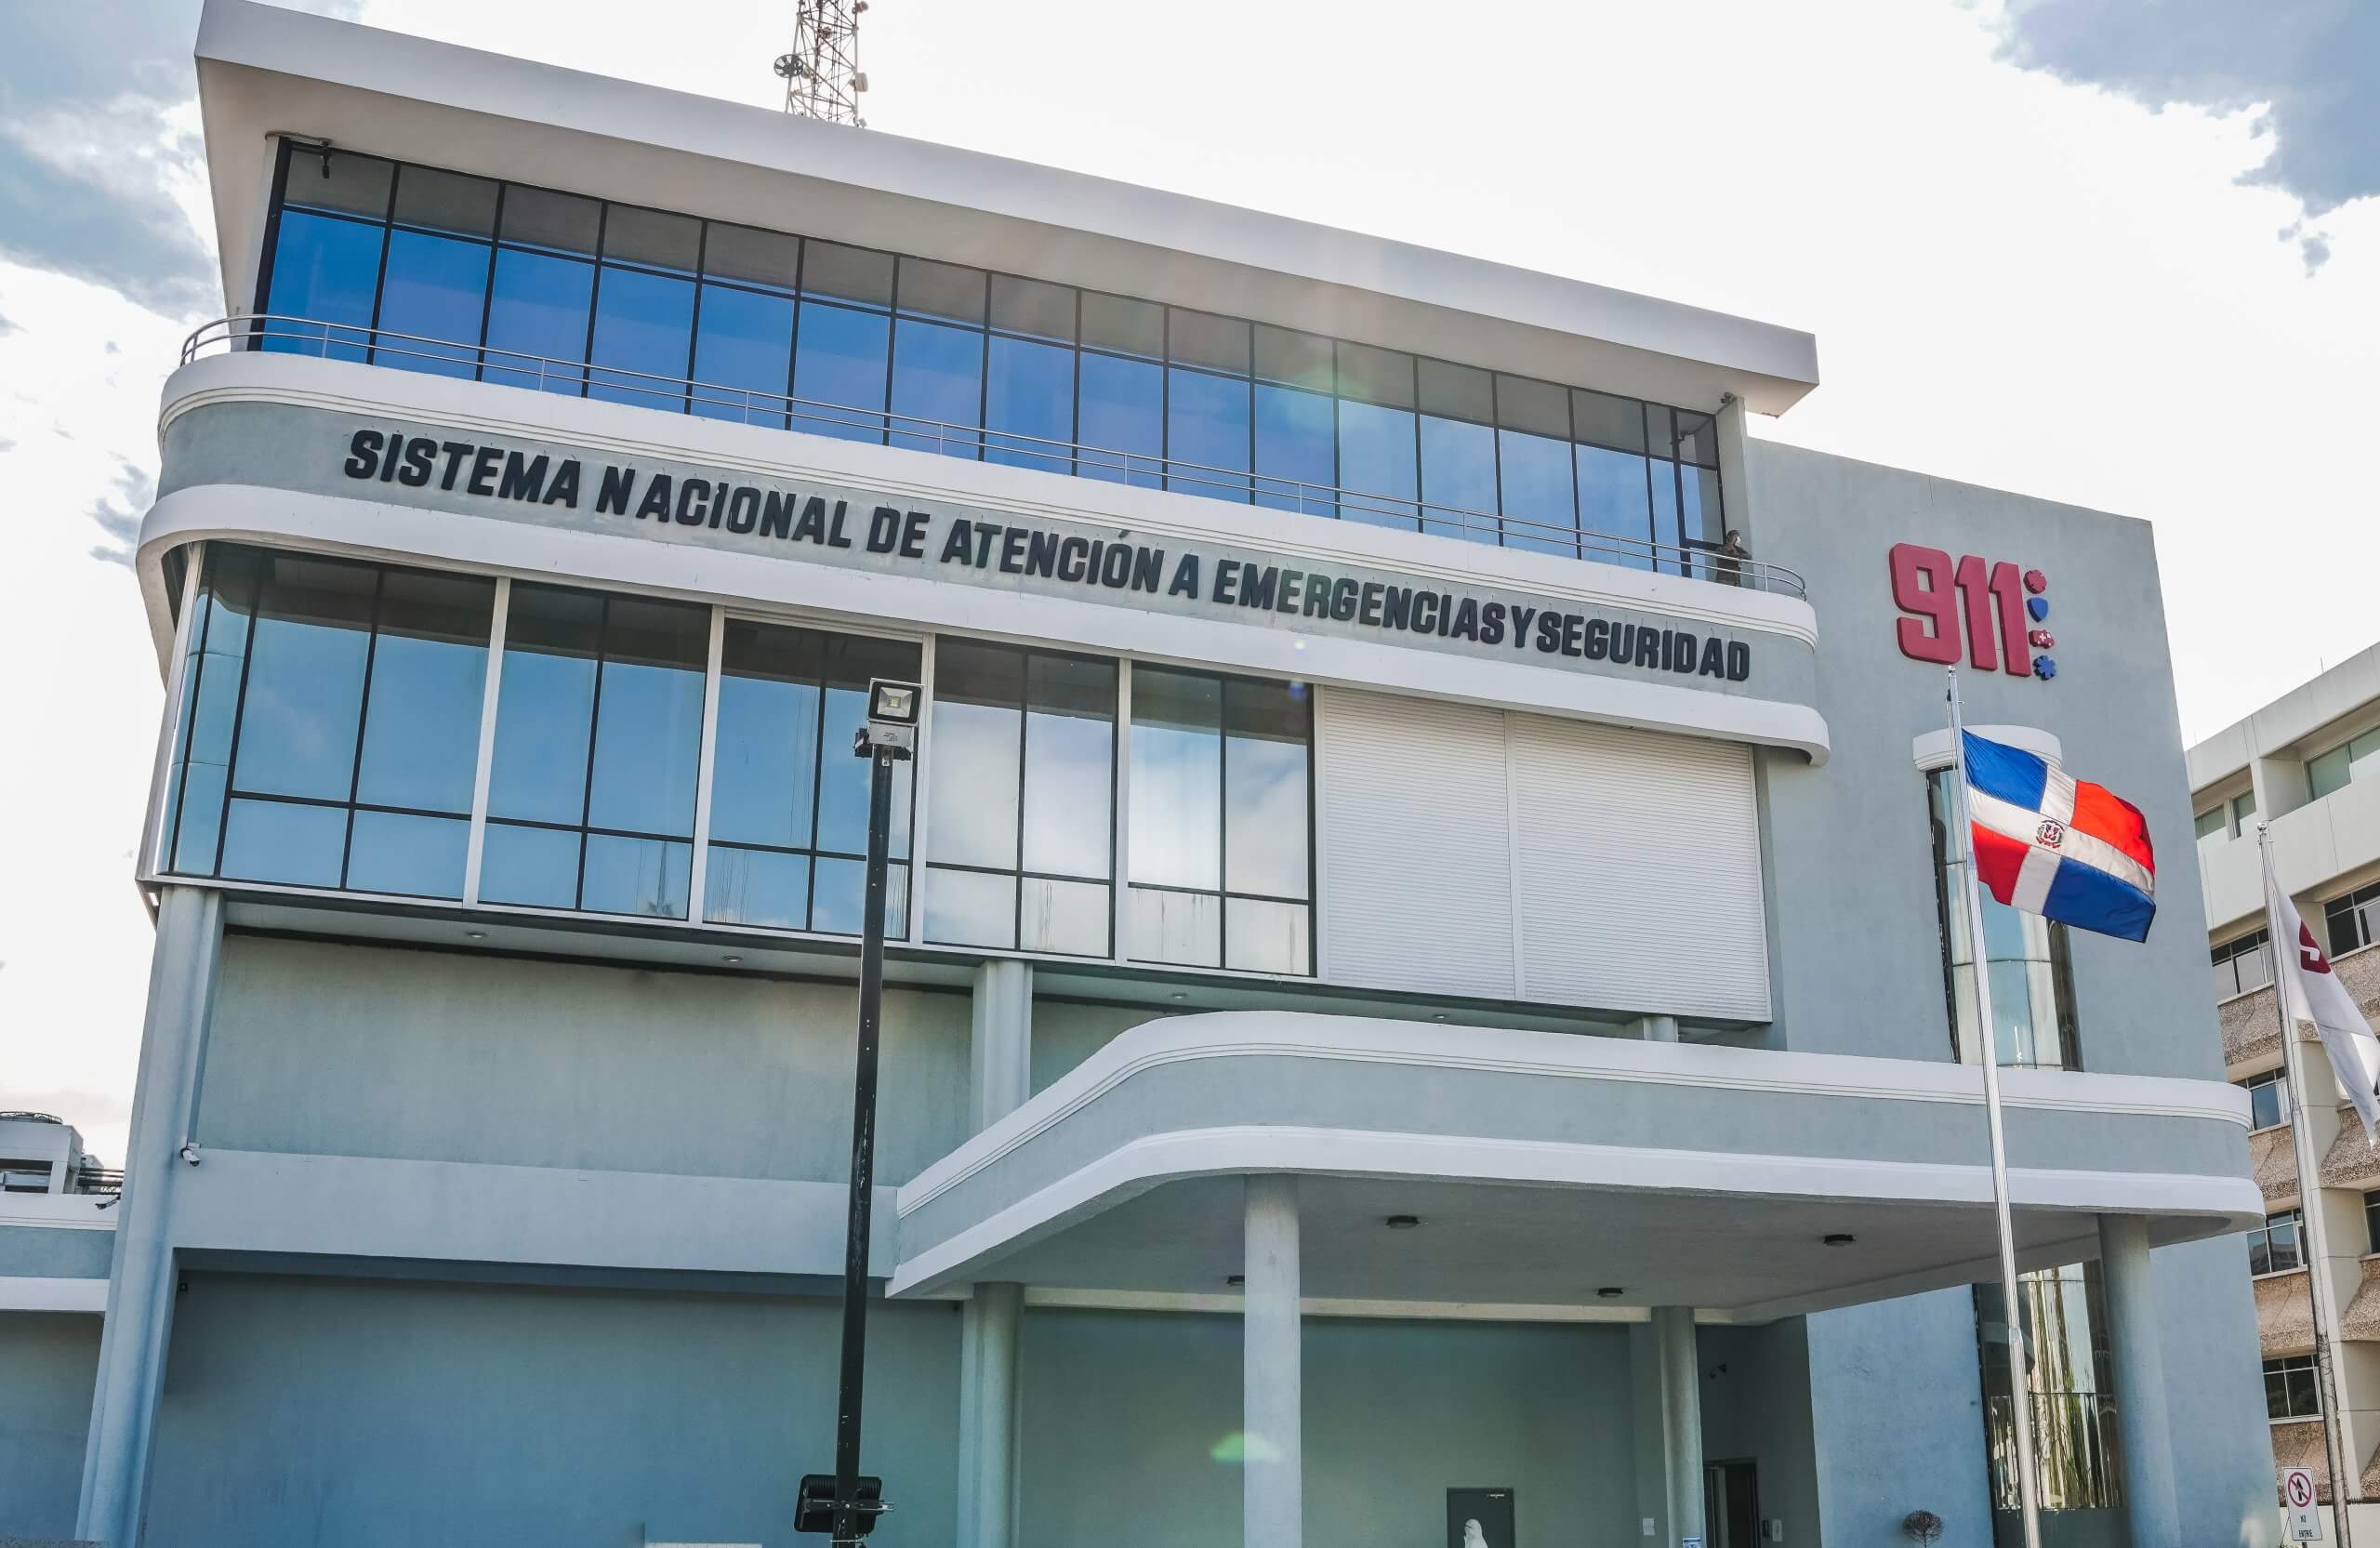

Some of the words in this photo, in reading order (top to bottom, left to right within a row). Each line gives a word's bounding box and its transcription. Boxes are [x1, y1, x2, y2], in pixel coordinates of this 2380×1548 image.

[344, 430, 581, 509] SISTEMA
[595, 466, 852, 548] NACIONAL
[866, 506, 931, 559] DE
[940, 519, 1165, 593] ATENCIÓN
[1168, 553, 1199, 600] A
[1211, 559, 1506, 645] EMERGENCIAS
[1536, 611, 1751, 681] SEGURIDAD
[1888, 542, 2032, 678] 911
